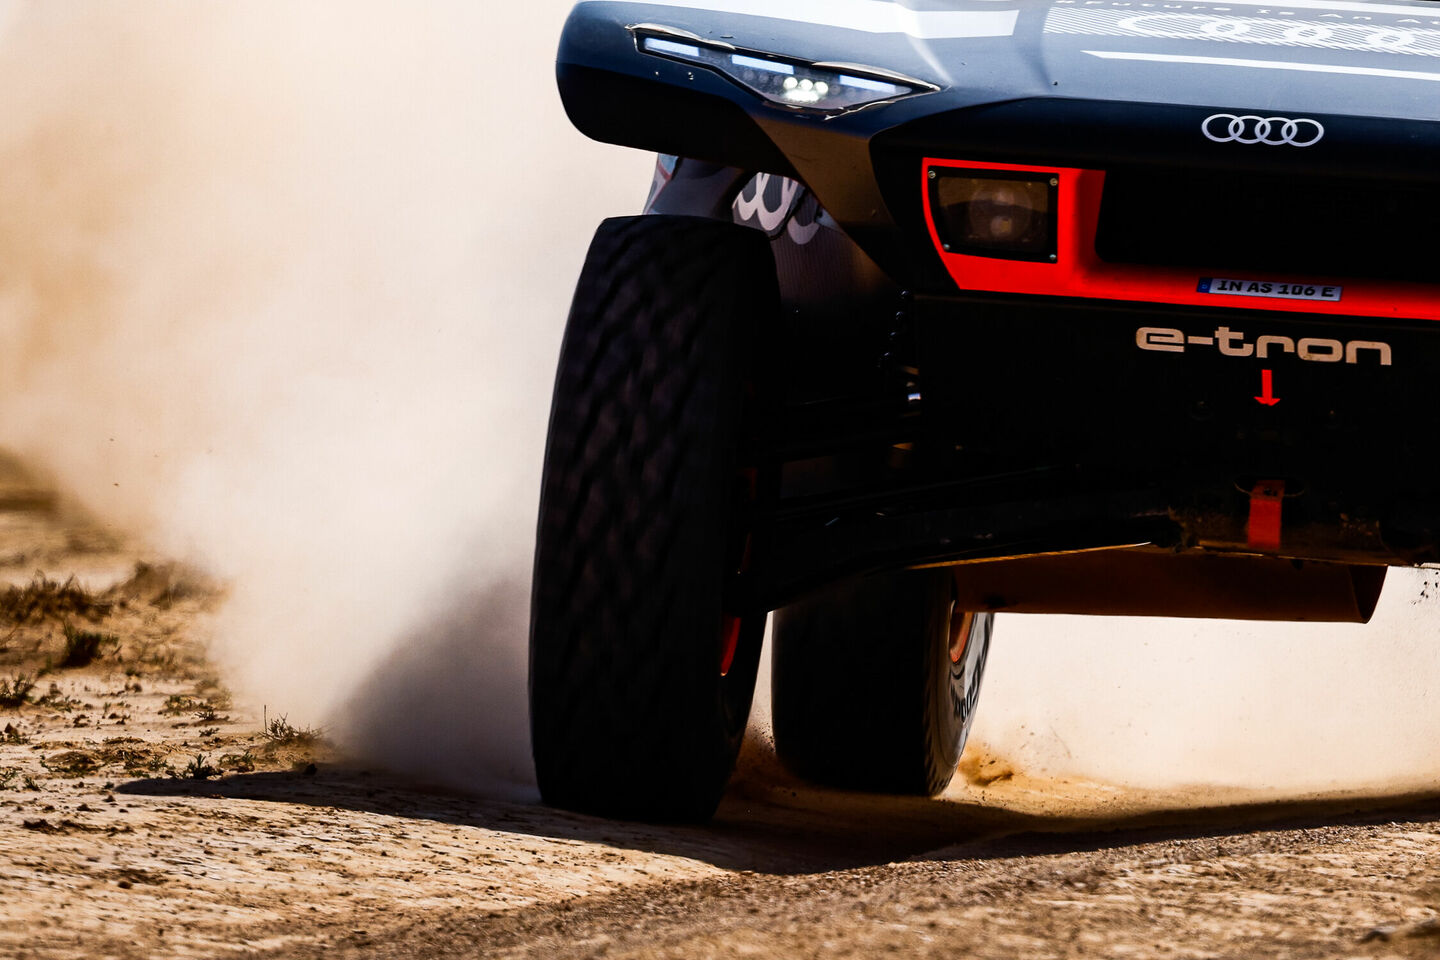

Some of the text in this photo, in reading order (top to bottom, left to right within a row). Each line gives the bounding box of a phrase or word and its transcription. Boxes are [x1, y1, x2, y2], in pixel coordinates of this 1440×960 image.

[1055, 0, 1232, 11] #Future
[1256, 8, 1296, 16] Is
[1318, 13, 1373, 21] An
[1217, 280, 1244, 292] IN
[1246, 283, 1273, 294] AS
[1277, 284, 1316, 296] 106
[1321, 286, 1336, 298] E
[1136, 326, 1392, 366] e-tron
